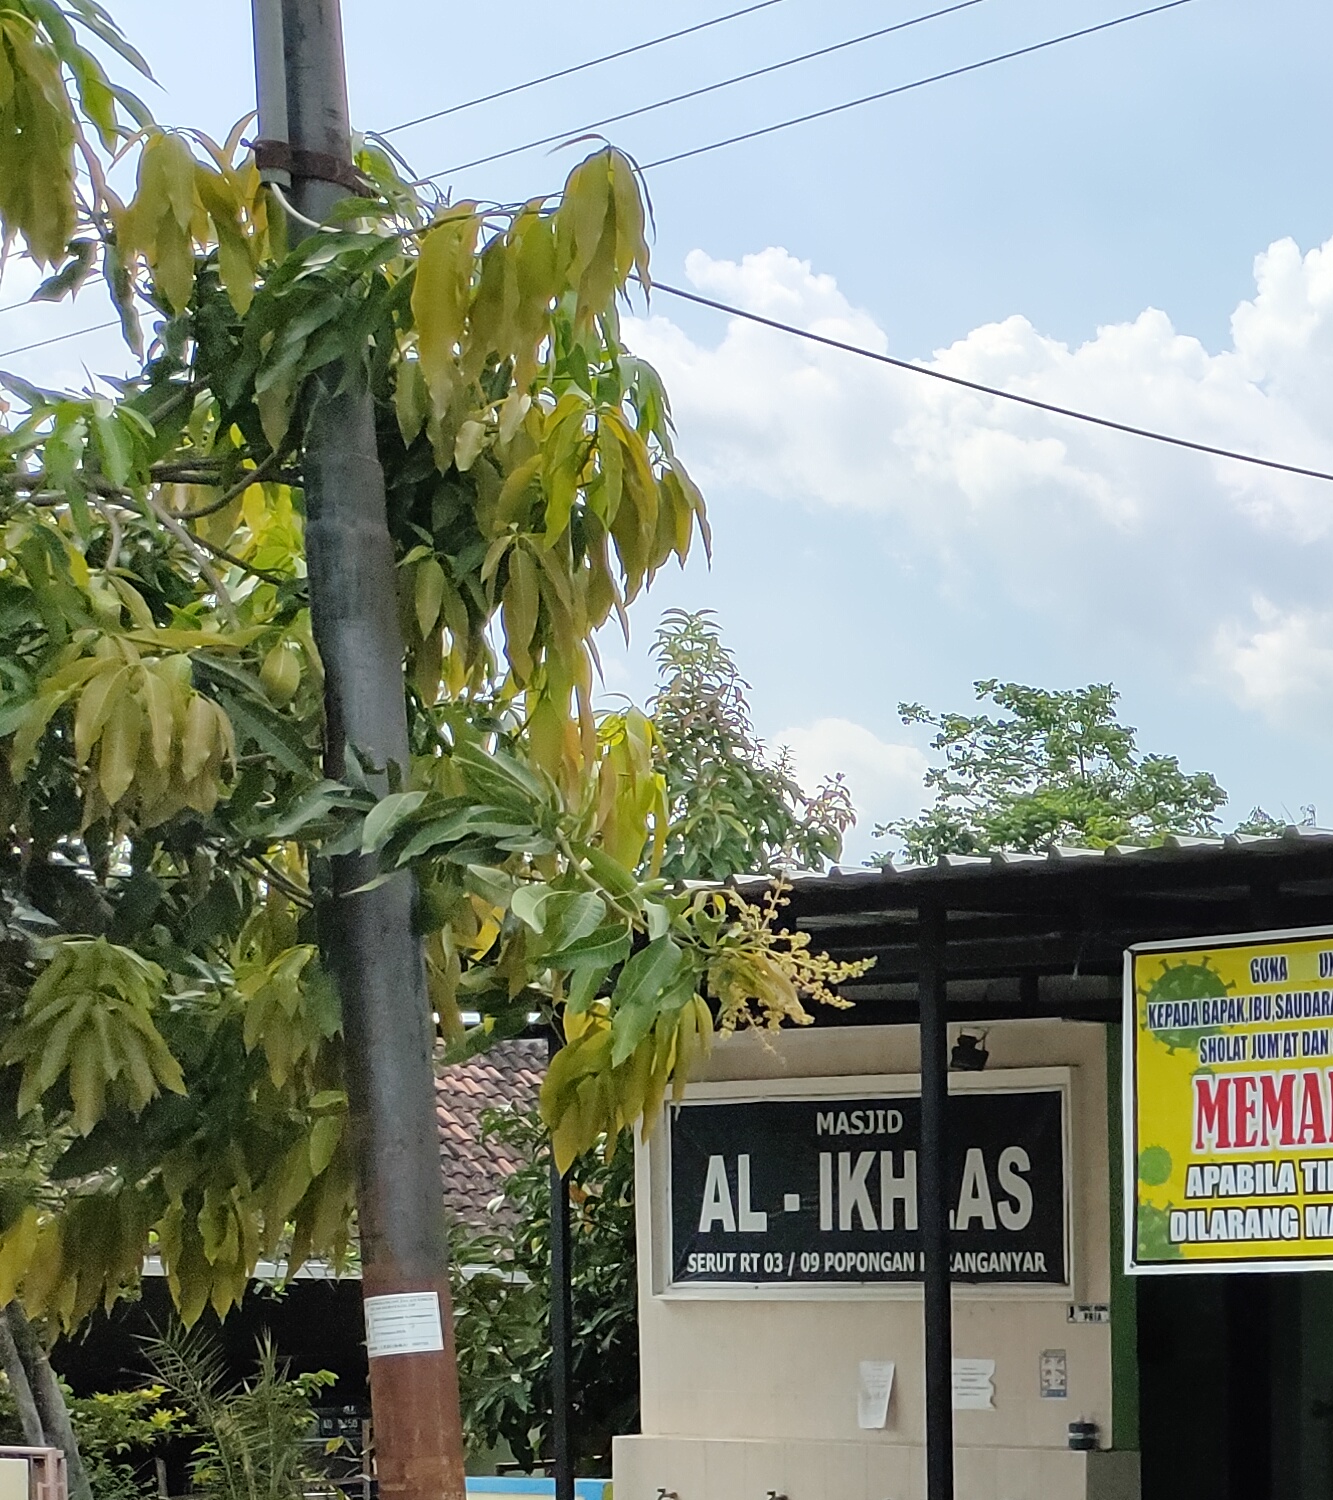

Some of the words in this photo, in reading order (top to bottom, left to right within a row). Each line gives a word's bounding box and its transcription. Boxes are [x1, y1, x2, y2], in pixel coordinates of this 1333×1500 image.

[1250, 957, 1287, 983] GUNA
[1149, 1001, 1199, 1029] KEPADA
[1200, 1036, 1248, 1063] SHOLAT
[1251, 1032, 1299, 1060] JUM'AT
[1302, 1029, 1329, 1056] DAN
[816, 1109, 903, 1136] MASJID
[699, 1154, 767, 1233] AL
[819, 1146, 1034, 1232] IKHAS
[1186, 1158, 1296, 1199] APABILA
[1170, 1205, 1299, 1243] DILARANG
[687, 1252, 737, 1274] SERUT
[740, 1252, 760, 1273] RT
[763, 1252, 783, 1273] 03
[787, 1253, 795, 1276] /
[800, 1252, 820, 1273] 09
[824, 1251, 915, 1272] POPONGAN
[919, 1251, 1047, 1273] ANGANYAR
